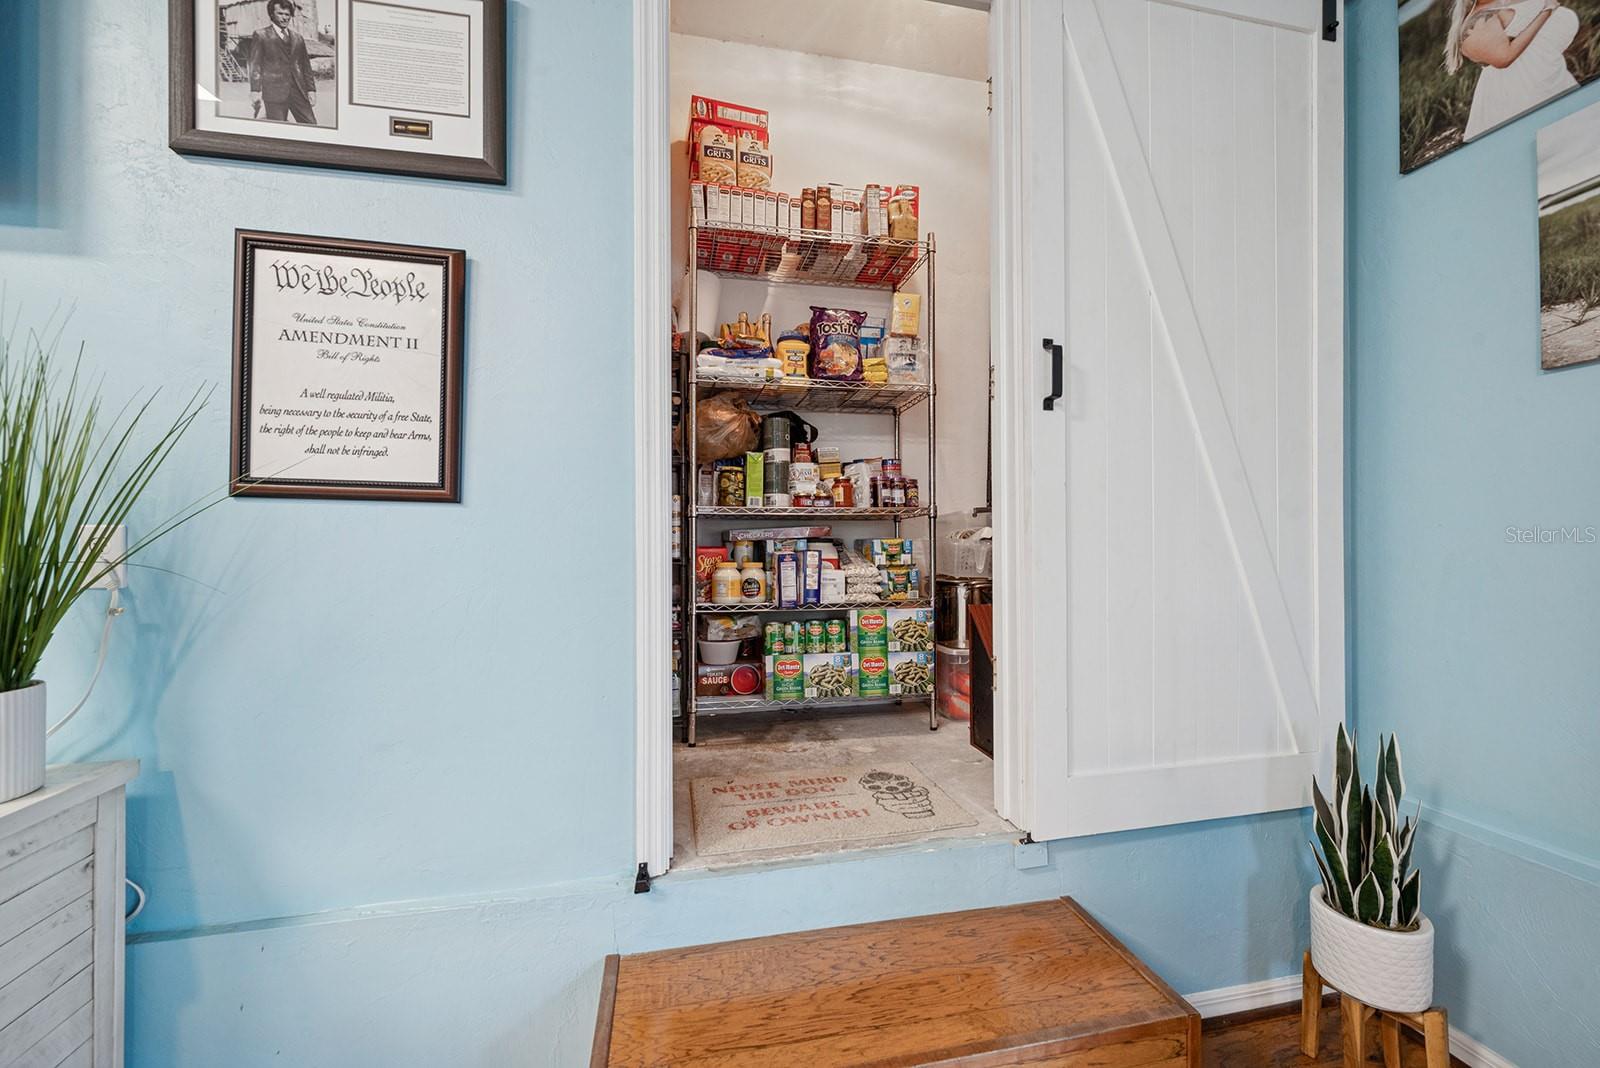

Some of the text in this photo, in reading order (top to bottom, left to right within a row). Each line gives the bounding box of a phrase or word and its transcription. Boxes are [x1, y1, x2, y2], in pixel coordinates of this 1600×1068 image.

[707, 148, 731, 159] GRITS
[743, 155, 767, 166] GRITS
[269, 260, 316, 294] We
[346, 267, 429, 306] People
[292, 312, 406, 330] United States Constitution
[278, 328, 419, 350] AMENDMENT II
[316, 349, 381, 365] Bill of Rights
[300, 388, 395, 403] A well regulated Militia,
[259, 404, 281, 418] being
[283, 408, 322, 420] necessary
[323, 409, 332, 418] to
[332, 408, 346, 418] the
[346, 410, 377, 423] security
[378, 410, 388, 423] of
[393, 411, 409, 423] free
[410, 412, 433, 424] State,
[259, 422, 432, 442] the right of the people to keep and bear Arms,
[304, 443, 388, 459] shall not be infringed.
[702, 676, 728, 685] SAUCE
[711, 776, 848, 794] NEVER MIND
[736, 786, 836, 801] THE DOG
[746, 801, 845, 818] BEWARE
[728, 808, 870, 831] OF OWNER!
